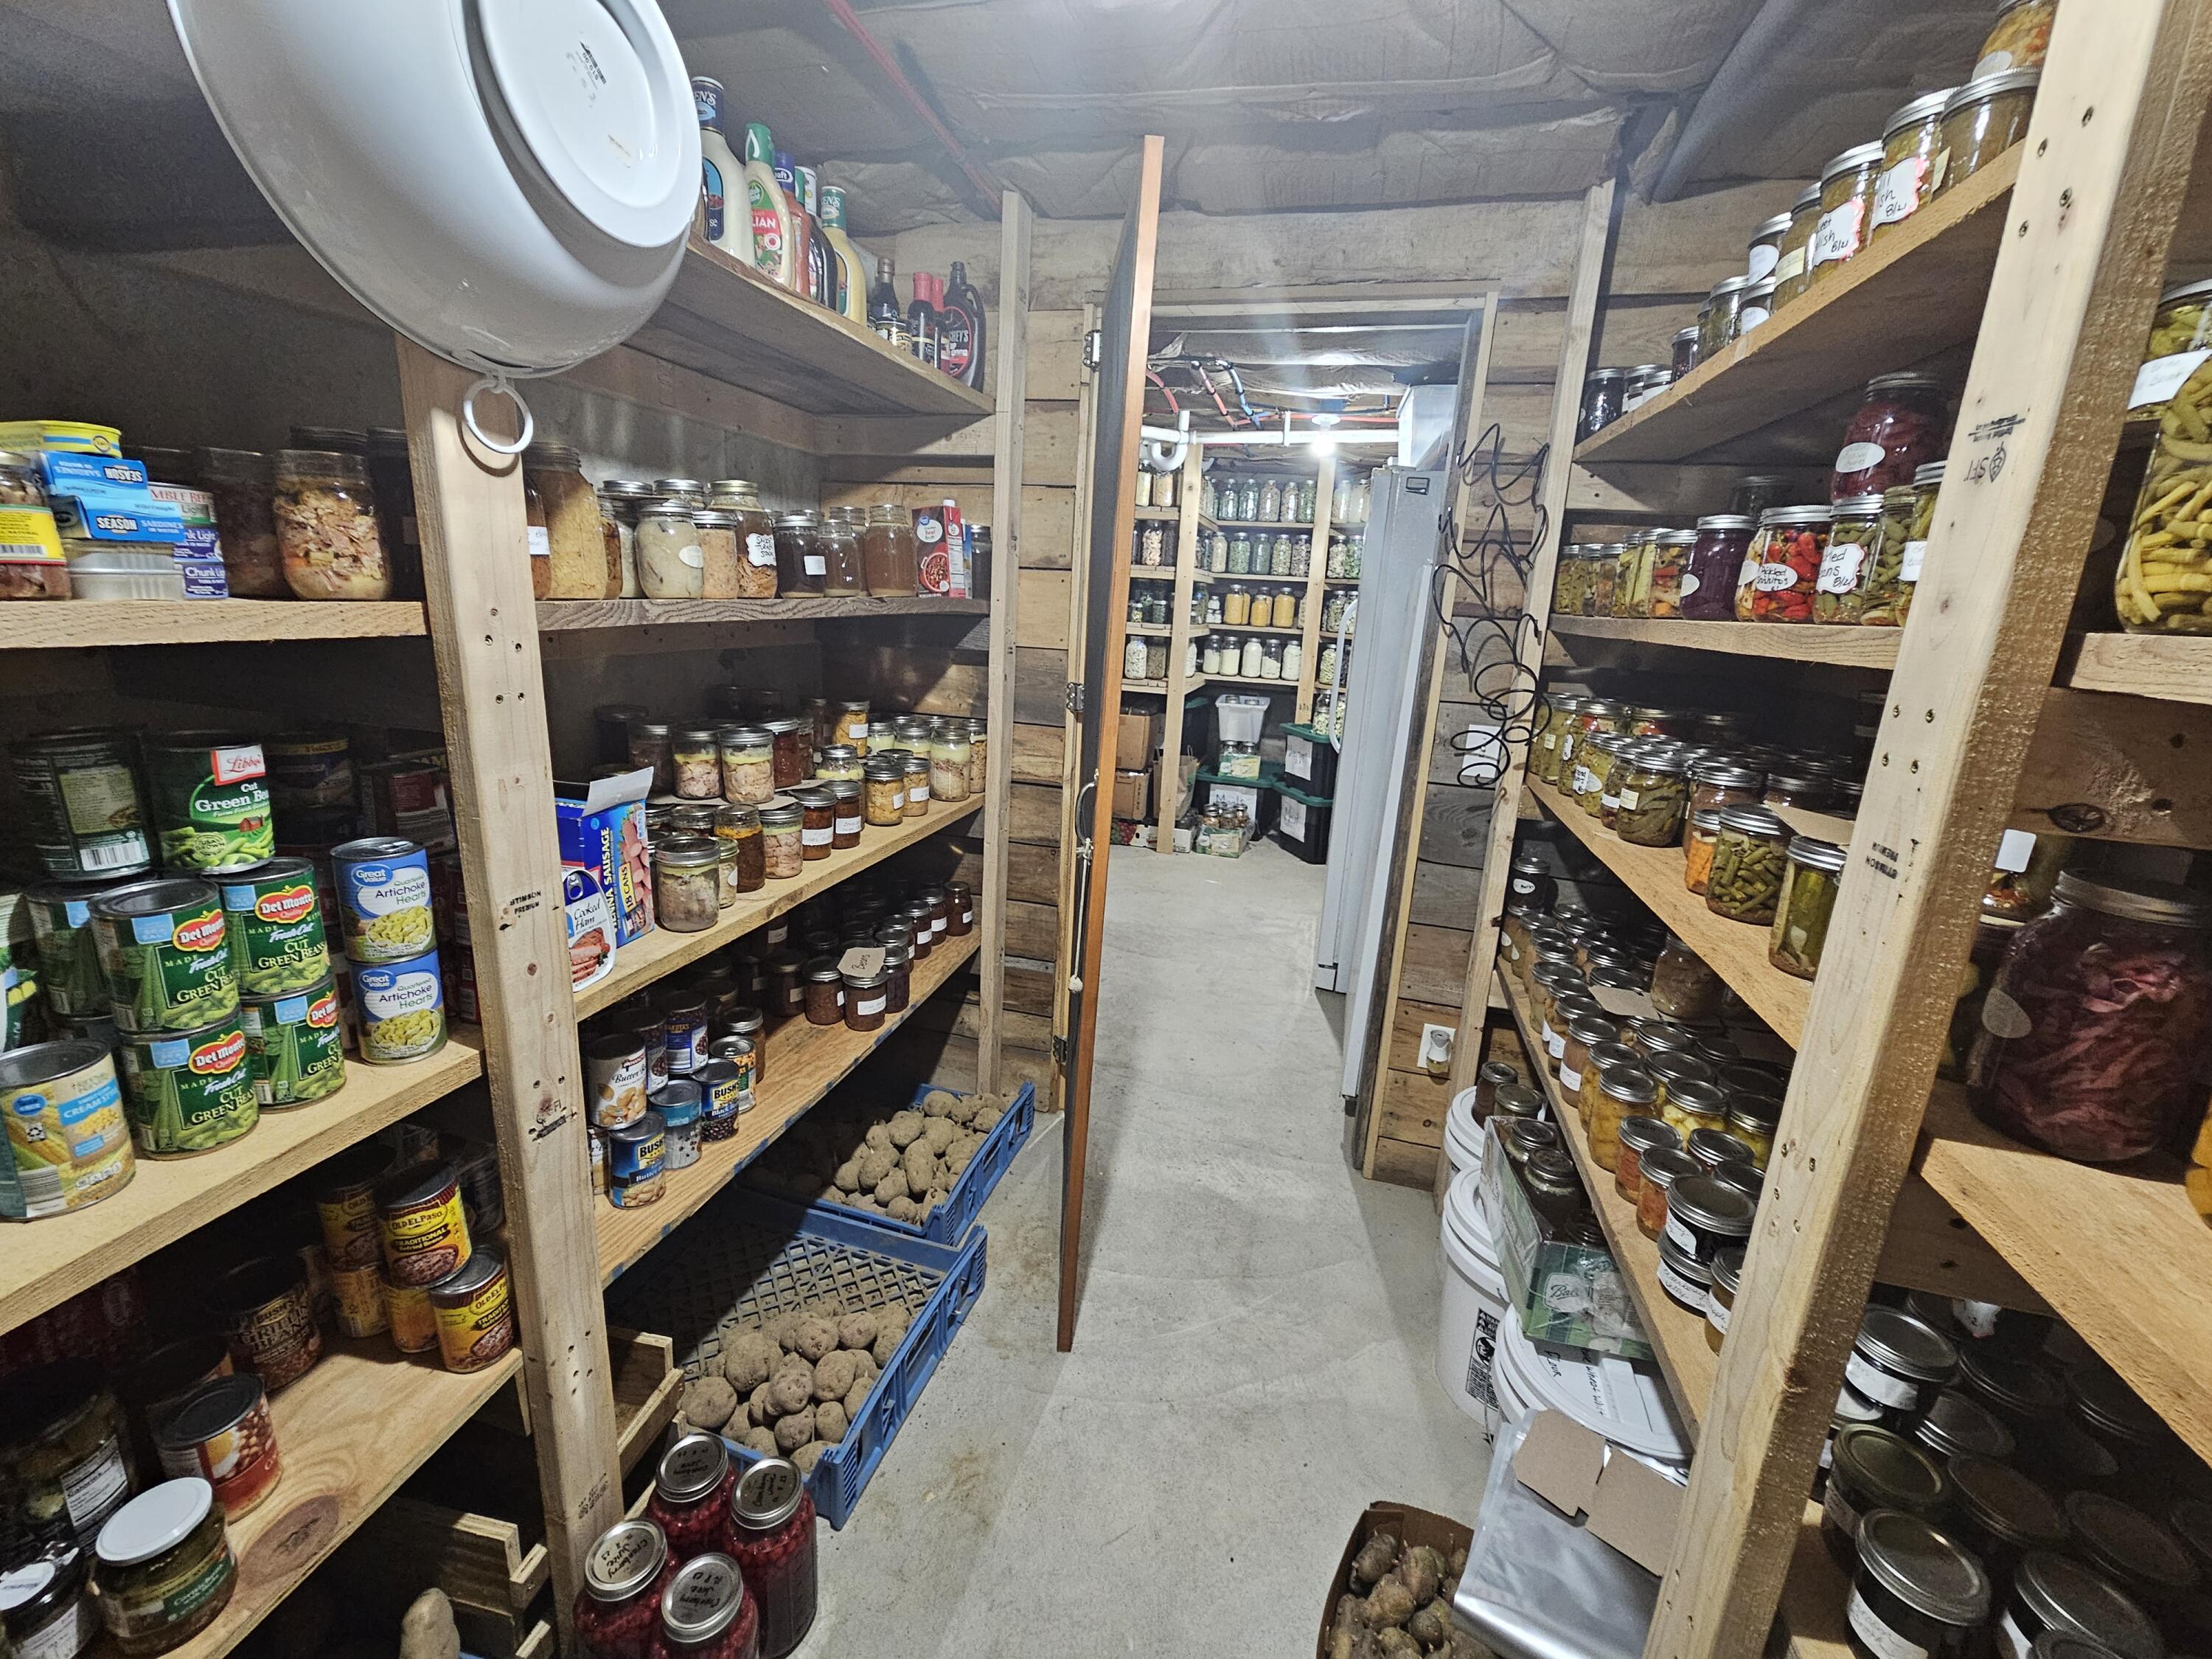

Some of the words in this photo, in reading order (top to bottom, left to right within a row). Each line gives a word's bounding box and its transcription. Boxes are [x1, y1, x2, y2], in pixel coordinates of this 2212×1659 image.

[693, 90, 717, 106] EN'S
[821, 196, 841, 207] EN'S
[752, 217, 776, 229] LIAN
[105, 467, 143, 482] SEASON
[181, 504, 209, 515] Light
[97, 516, 138, 532] SEASON
[184, 566, 214, 578] Chunk
[240, 782, 258, 793] Cut
[195, 795, 251, 812] Green
[253, 789, 269, 800] Bea
[600, 827, 613, 886] SAUSAGE
[355, 869, 386, 880] Great
[394, 874, 425, 886] Quartered
[622, 866, 630, 894] CANS
[375, 881, 425, 899] Artichoke
[260, 901, 283, 914] Del
[283, 894, 313, 909] Monte
[396, 891, 426, 905] Hearts
[626, 894, 634, 908] 18
[574, 897, 601, 921] Cooked
[606, 887, 618, 931] IENNA
[248, 925, 278, 934] MADE
[575, 916, 595, 931] Ham
[179, 930, 202, 943] Del
[268, 928, 296, 943] Fresh
[294, 922, 316, 935] Cut
[284, 939, 309, 953] CUT
[164, 954, 199, 967] MADE
[258, 950, 301, 969] GREEN
[204, 966, 226, 983] CUT
[362, 974, 390, 983] Great
[176, 981, 220, 1003] GREEN
[397, 978, 431, 991] Quartered
[379, 984, 432, 1003] Artichoke
[399, 994, 433, 1009] Hearts
[311, 1009, 325, 1021] Del
[299, 1031, 324, 1043] MADE
[195, 1054, 218, 1067] Del
[181, 1077, 214, 1090] MADE
[612, 1071, 638, 1085] Butter
[204, 1079, 232, 1096] Fresh
[220, 1085, 244, 1105] CUT
[63, 1099, 102, 1119] CREAM
[191, 1102, 235, 1124] GREEN
[712, 1107, 730, 1117] Black
[394, 1227, 448, 1246] TRADITIONAL
[607, 1538, 648, 1579] Cranberry
